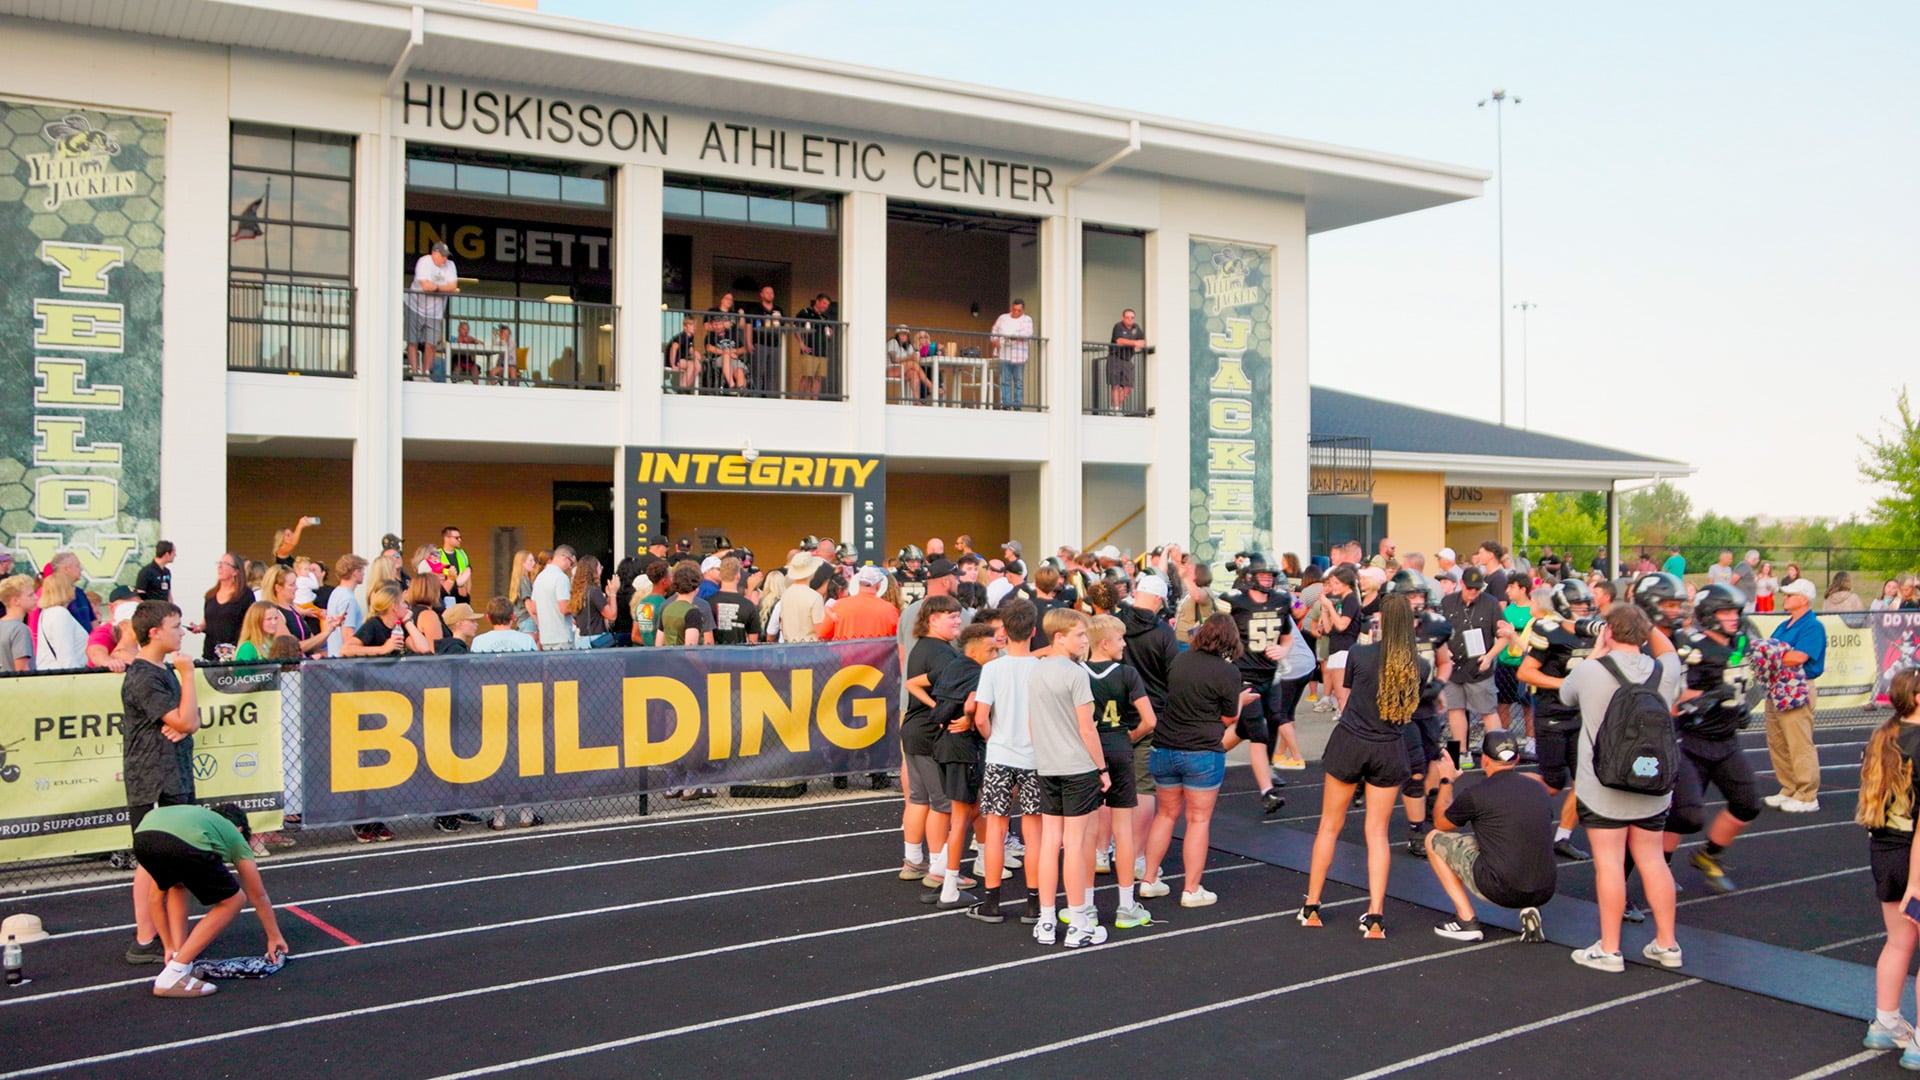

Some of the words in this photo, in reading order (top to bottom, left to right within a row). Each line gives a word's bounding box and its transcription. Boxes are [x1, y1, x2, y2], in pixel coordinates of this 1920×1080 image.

[404, 82, 668, 156] HUSKISSON
[700, 121, 886, 182] ATHLETIC
[913, 150, 1054, 205] CENTER
[31, 157, 104, 181] YELLOW
[47, 176, 134, 206] JACKETS
[496, 227, 614, 270] BETT
[16, 240, 139, 583] YELLOW
[637, 452, 879, 488] INTEGRITY
[864, 501, 874, 549] HOME
[1248, 618, 1281, 652] 55
[1883, 613, 1901, 627] DO
[217, 676, 233, 685] GO
[330, 664, 887, 793] BUILDING
[1092, 700, 1121, 728] 4
[53, 777, 100, 786] BUICK
[0, 822, 40, 835] ROUD
[43, 813, 113, 831] SUPPORTER
